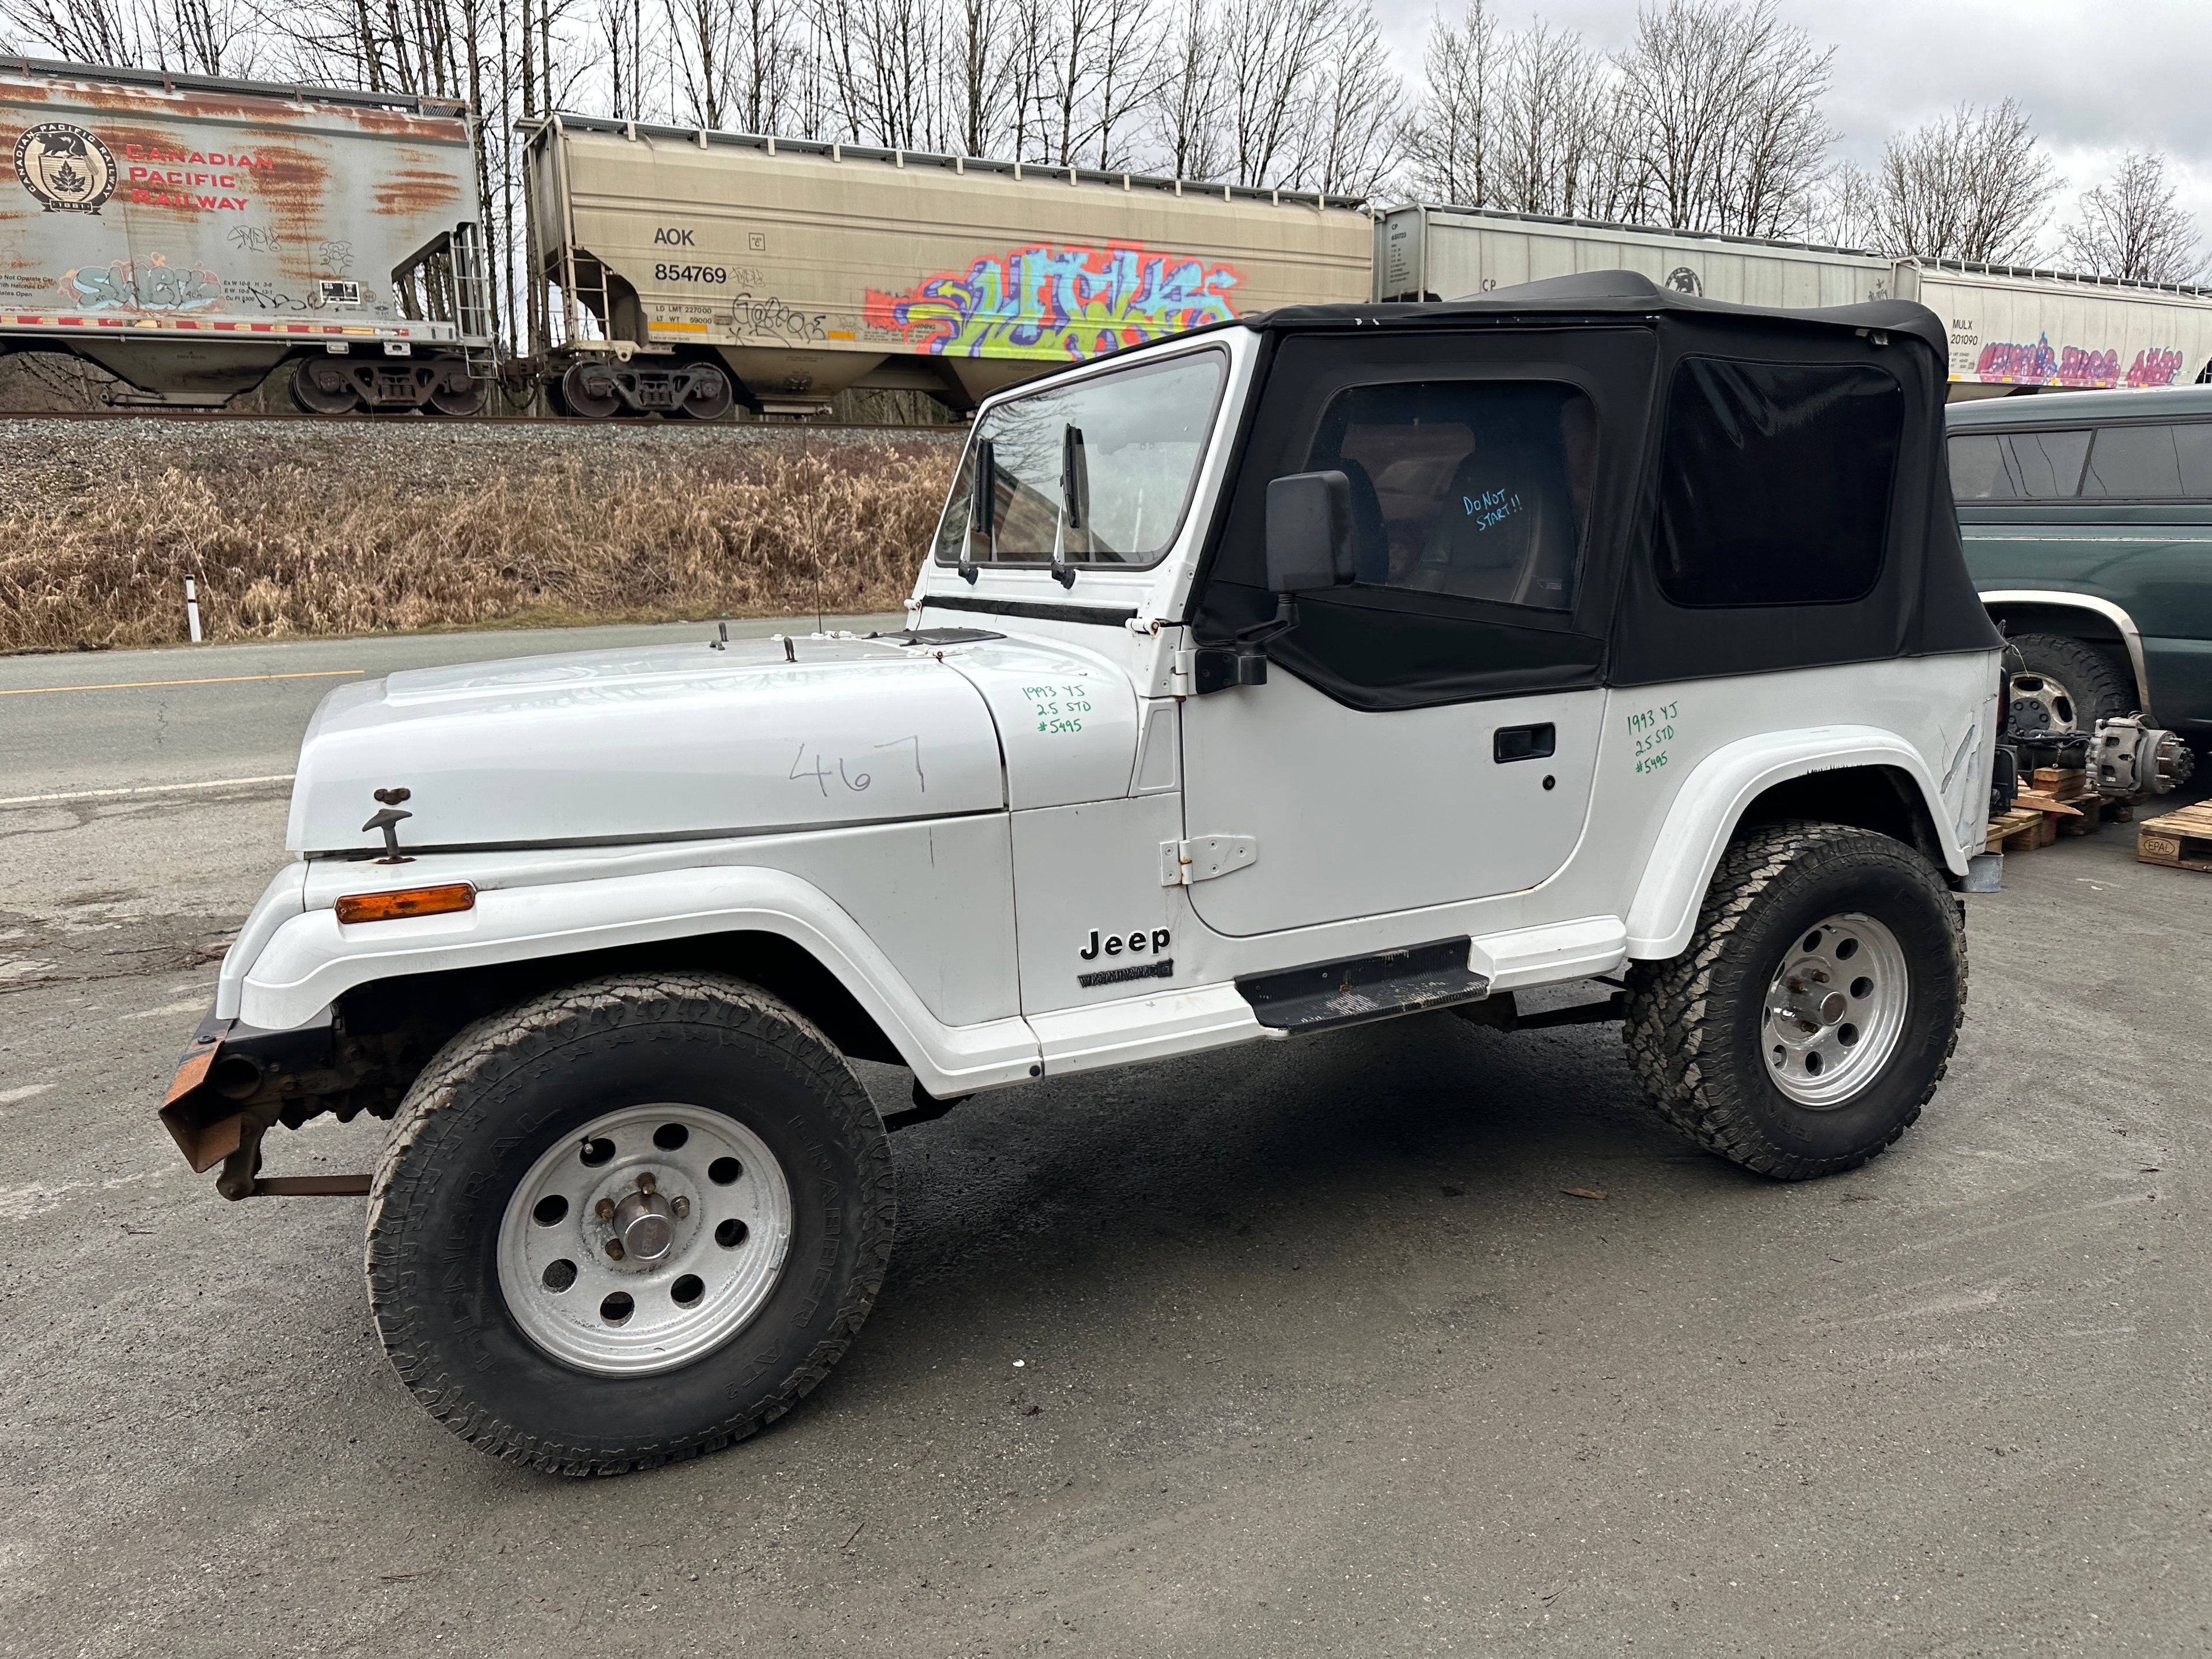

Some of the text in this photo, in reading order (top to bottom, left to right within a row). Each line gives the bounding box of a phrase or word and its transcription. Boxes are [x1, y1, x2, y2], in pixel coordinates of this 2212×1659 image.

[16, 124, 115, 198] CANADIAN PACIFIC RAILWAY
[126, 143, 273, 169] CANADIAN
[128, 166, 236, 188] PACIFIC
[132, 188, 249, 211] RAILWAY
[654, 228, 695, 246] AOK
[655, 264, 726, 283] 854769
[1482, 279, 1496, 291] CP
[1953, 319, 1973, 330] MULX
[1950, 334, 1978, 346] 201090
[1482, 488, 1505, 510] NOT
[1022, 685, 1057, 700] 1993
[1037, 701, 1092, 715] 2.5 STD
[1628, 700, 1677, 736] 1993 YJ
[1037, 718, 1082, 733] #5495
[1635, 725, 1674, 757] 2.5 STD
[789, 735, 925, 797] 467
[1635, 751, 1668, 774] #5495
[2148, 841, 2169, 853] EPAL
[1080, 927, 1171, 960] Jeep
